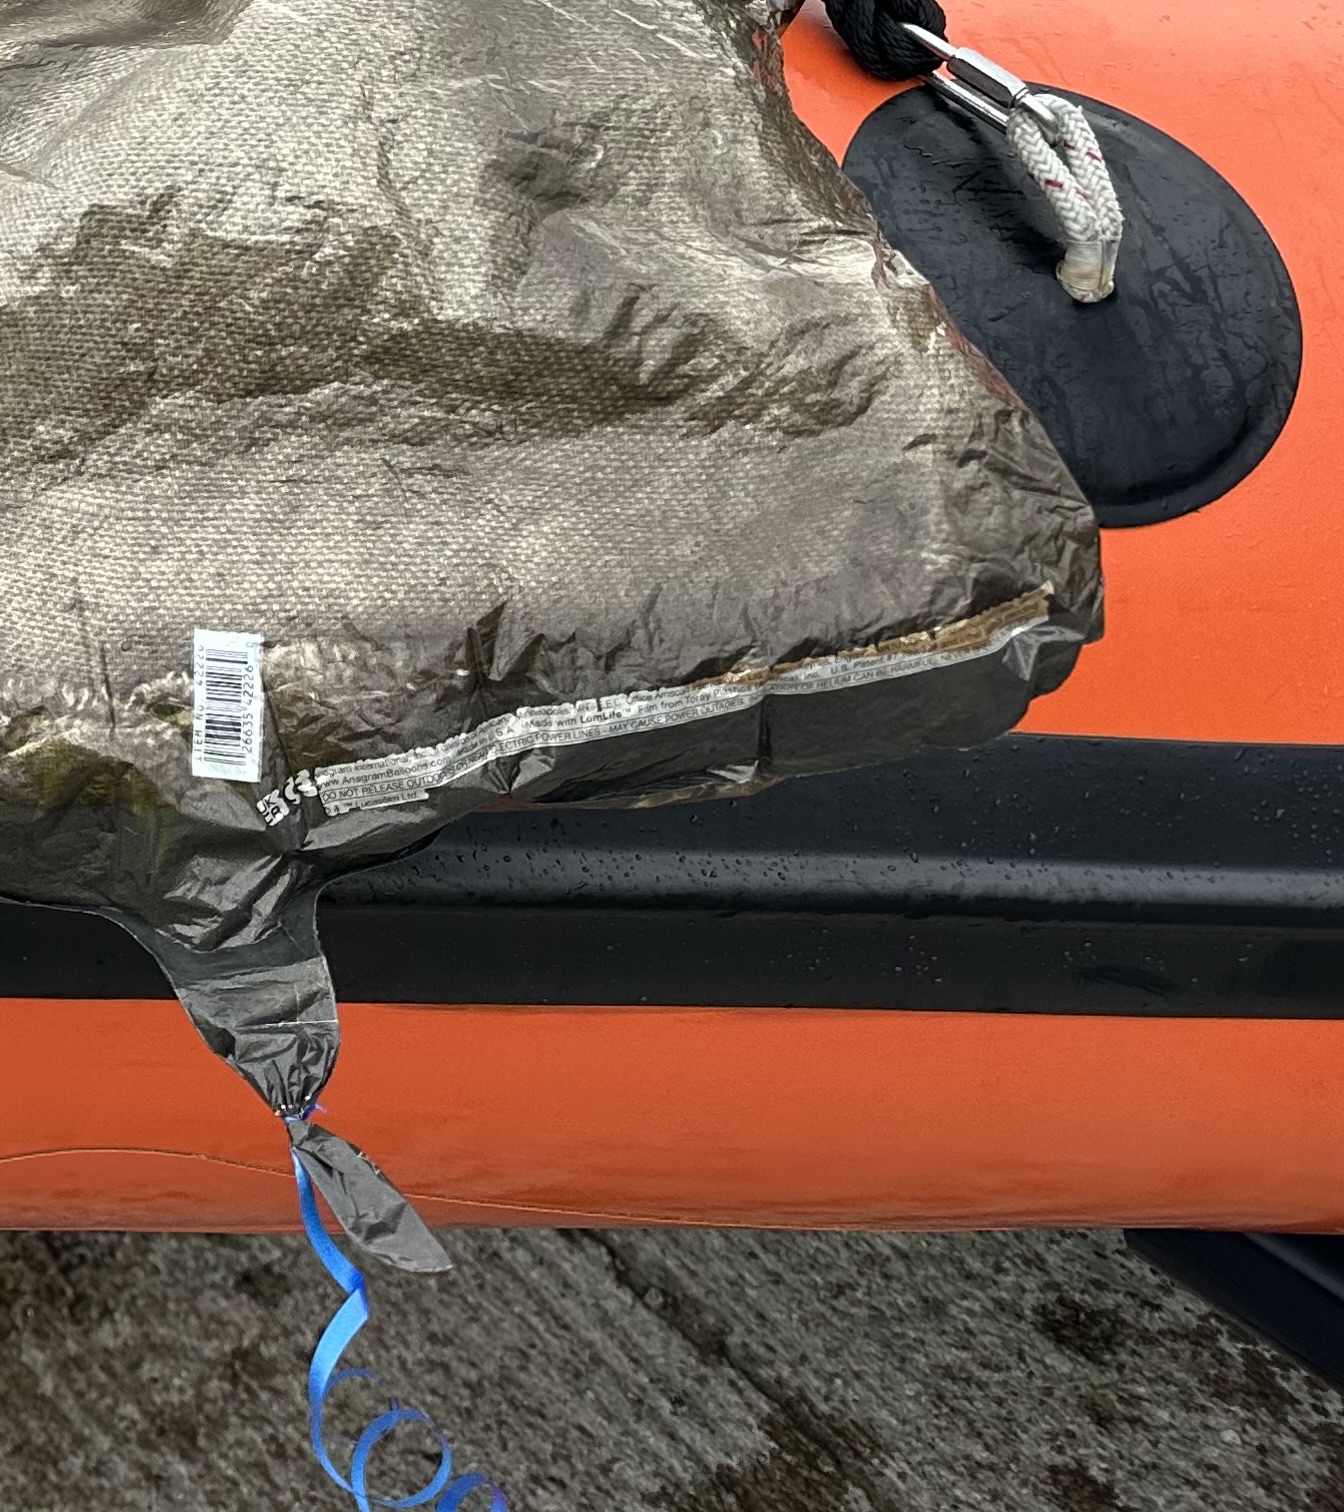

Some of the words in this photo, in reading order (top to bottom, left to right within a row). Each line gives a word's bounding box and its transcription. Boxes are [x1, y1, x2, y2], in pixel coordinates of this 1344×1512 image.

[243, 664, 254, 706] 42226
[242, 712, 253, 754] 26635
[339, 787, 359, 799] NOT
[361, 781, 404, 796] RELEASE
[535, 731, 572, 743] POWER
[572, 728, 601, 740] LINES
[609, 722, 629, 733] MAY
[630, 716, 664, 729] CAUSE
[664, 707, 699, 722] POWER
[853, 670, 874, 682] CAN
[556, 716, 577, 728] with
[637, 702, 658, 715] Film
[660, 699, 684, 710] from
[193, 729, 204, 763] ITEM
